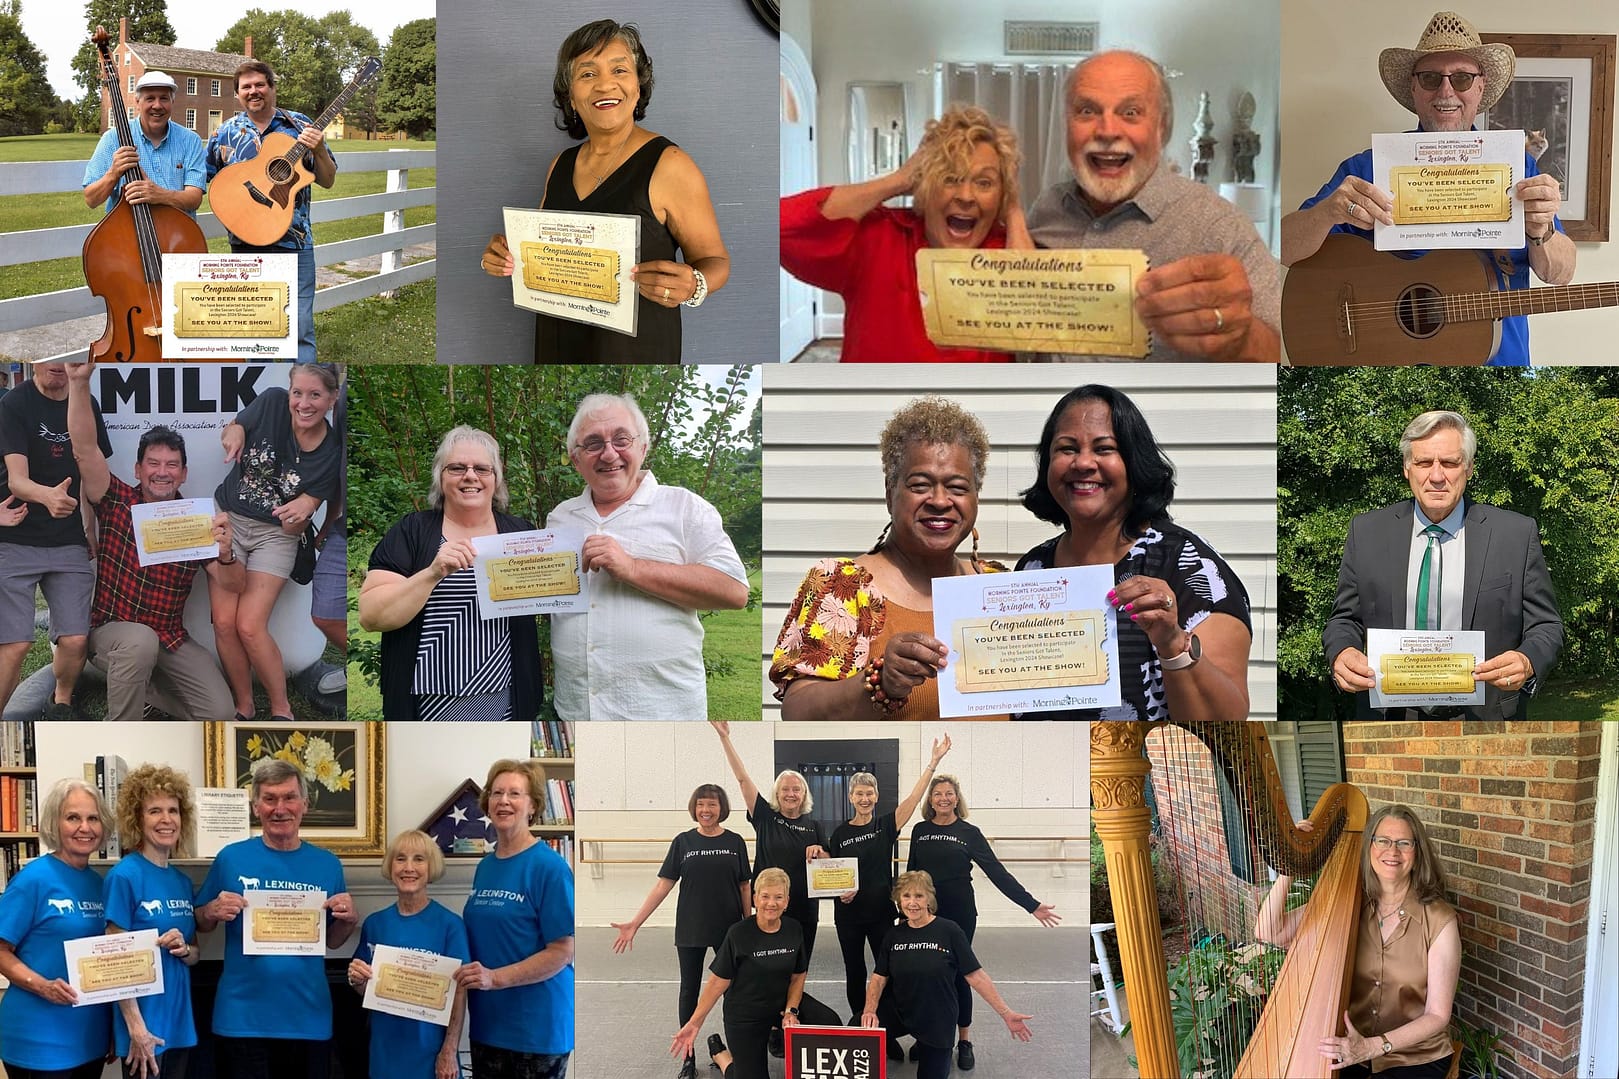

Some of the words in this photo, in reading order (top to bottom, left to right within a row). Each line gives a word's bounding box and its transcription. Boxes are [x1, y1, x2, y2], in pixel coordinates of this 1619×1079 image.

[1460, 154, 1469, 162] Ky
[1420, 168, 1480, 179] Congratulations
[1451, 230, 1477, 238] Morning
[543, 246, 591, 258] Congratulations
[573, 260, 605, 268] SELECTED
[971, 255, 1085, 274] Congratulations
[203, 284, 259, 294] Congratulations
[950, 279, 998, 289] YOU'VE
[1002, 280, 1038, 290] BEEN
[1042, 281, 1116, 292] SELECTED
[957, 319, 981, 328] SEE
[986, 320, 1012, 330] YOU
[1016, 322, 1034, 331] AT
[1038, 323, 1064, 332] THE
[1068, 324, 1114, 335] SHOW!
[100, 366, 266, 414] MILK
[170, 420, 216, 430] Association
[508, 556, 553, 566] Congratulations
[987, 596, 1018, 604] SENIORS
[1037, 592, 1065, 601] TALENT
[1038, 599, 1051, 610] Ky
[990, 617, 1065, 632] Congratulations
[975, 636, 1008, 644] YOU'VE
[1010, 634, 1035, 642] BEEN
[1037, 630, 1086, 640] SELECTED
[1055, 662, 1085, 670] SHOW!
[974, 701, 1012, 712] partnership
[1032, 696, 1066, 708] Morning
[1071, 694, 1097, 705] Pointe
[265, 880, 321, 892] LEXINGTON
[477, 890, 524, 903] LEXINGTON
[802, 1048, 848, 1075] LEX
